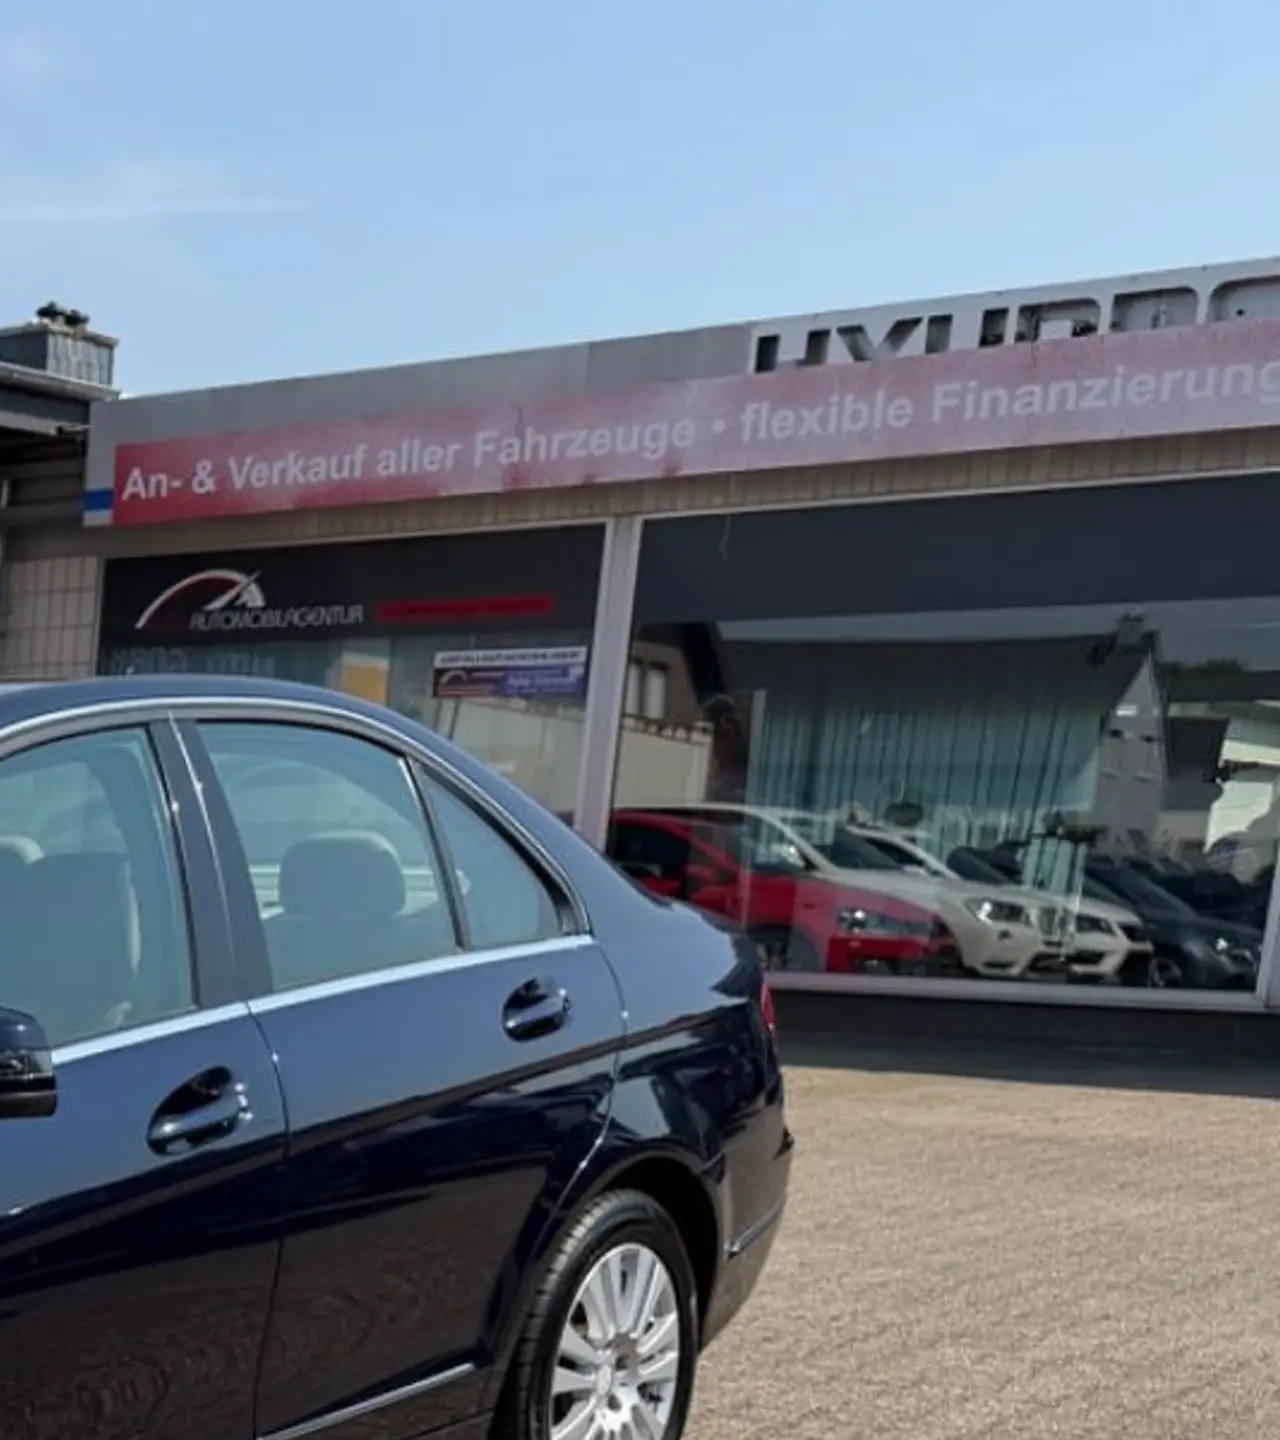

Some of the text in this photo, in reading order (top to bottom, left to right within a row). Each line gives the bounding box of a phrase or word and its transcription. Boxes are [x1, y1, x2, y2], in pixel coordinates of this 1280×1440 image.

[123, 359, 1280, 500] An- & Verkauf aller Fahrzeuge flexible Finanzierung
